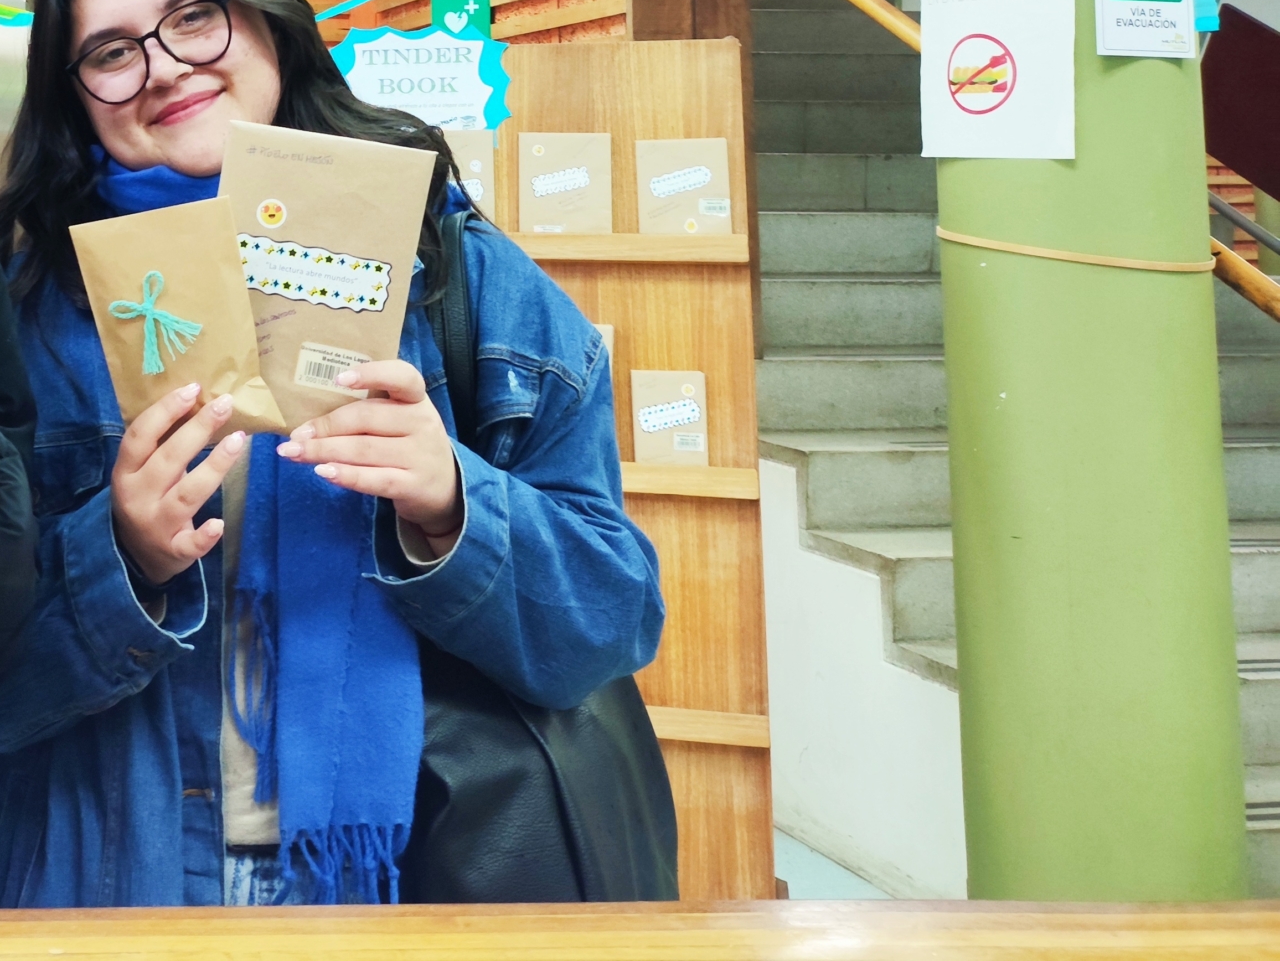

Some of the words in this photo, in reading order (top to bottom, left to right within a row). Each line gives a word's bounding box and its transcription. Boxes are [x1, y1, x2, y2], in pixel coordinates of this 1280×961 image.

[1130, 5, 1146, 17] VÍA
[1148, 8, 1162, 18] DE
[1116, 18, 1177, 29] EVACUACIÓN
[362, 46, 474, 66] TINDER
[378, 76, 458, 95] BOOK
[278, 264, 304, 276] lectura
[306, 270, 322, 278] abre
[300, 344, 334, 357] Universidad
[322, 356, 350, 367] Medioteca
